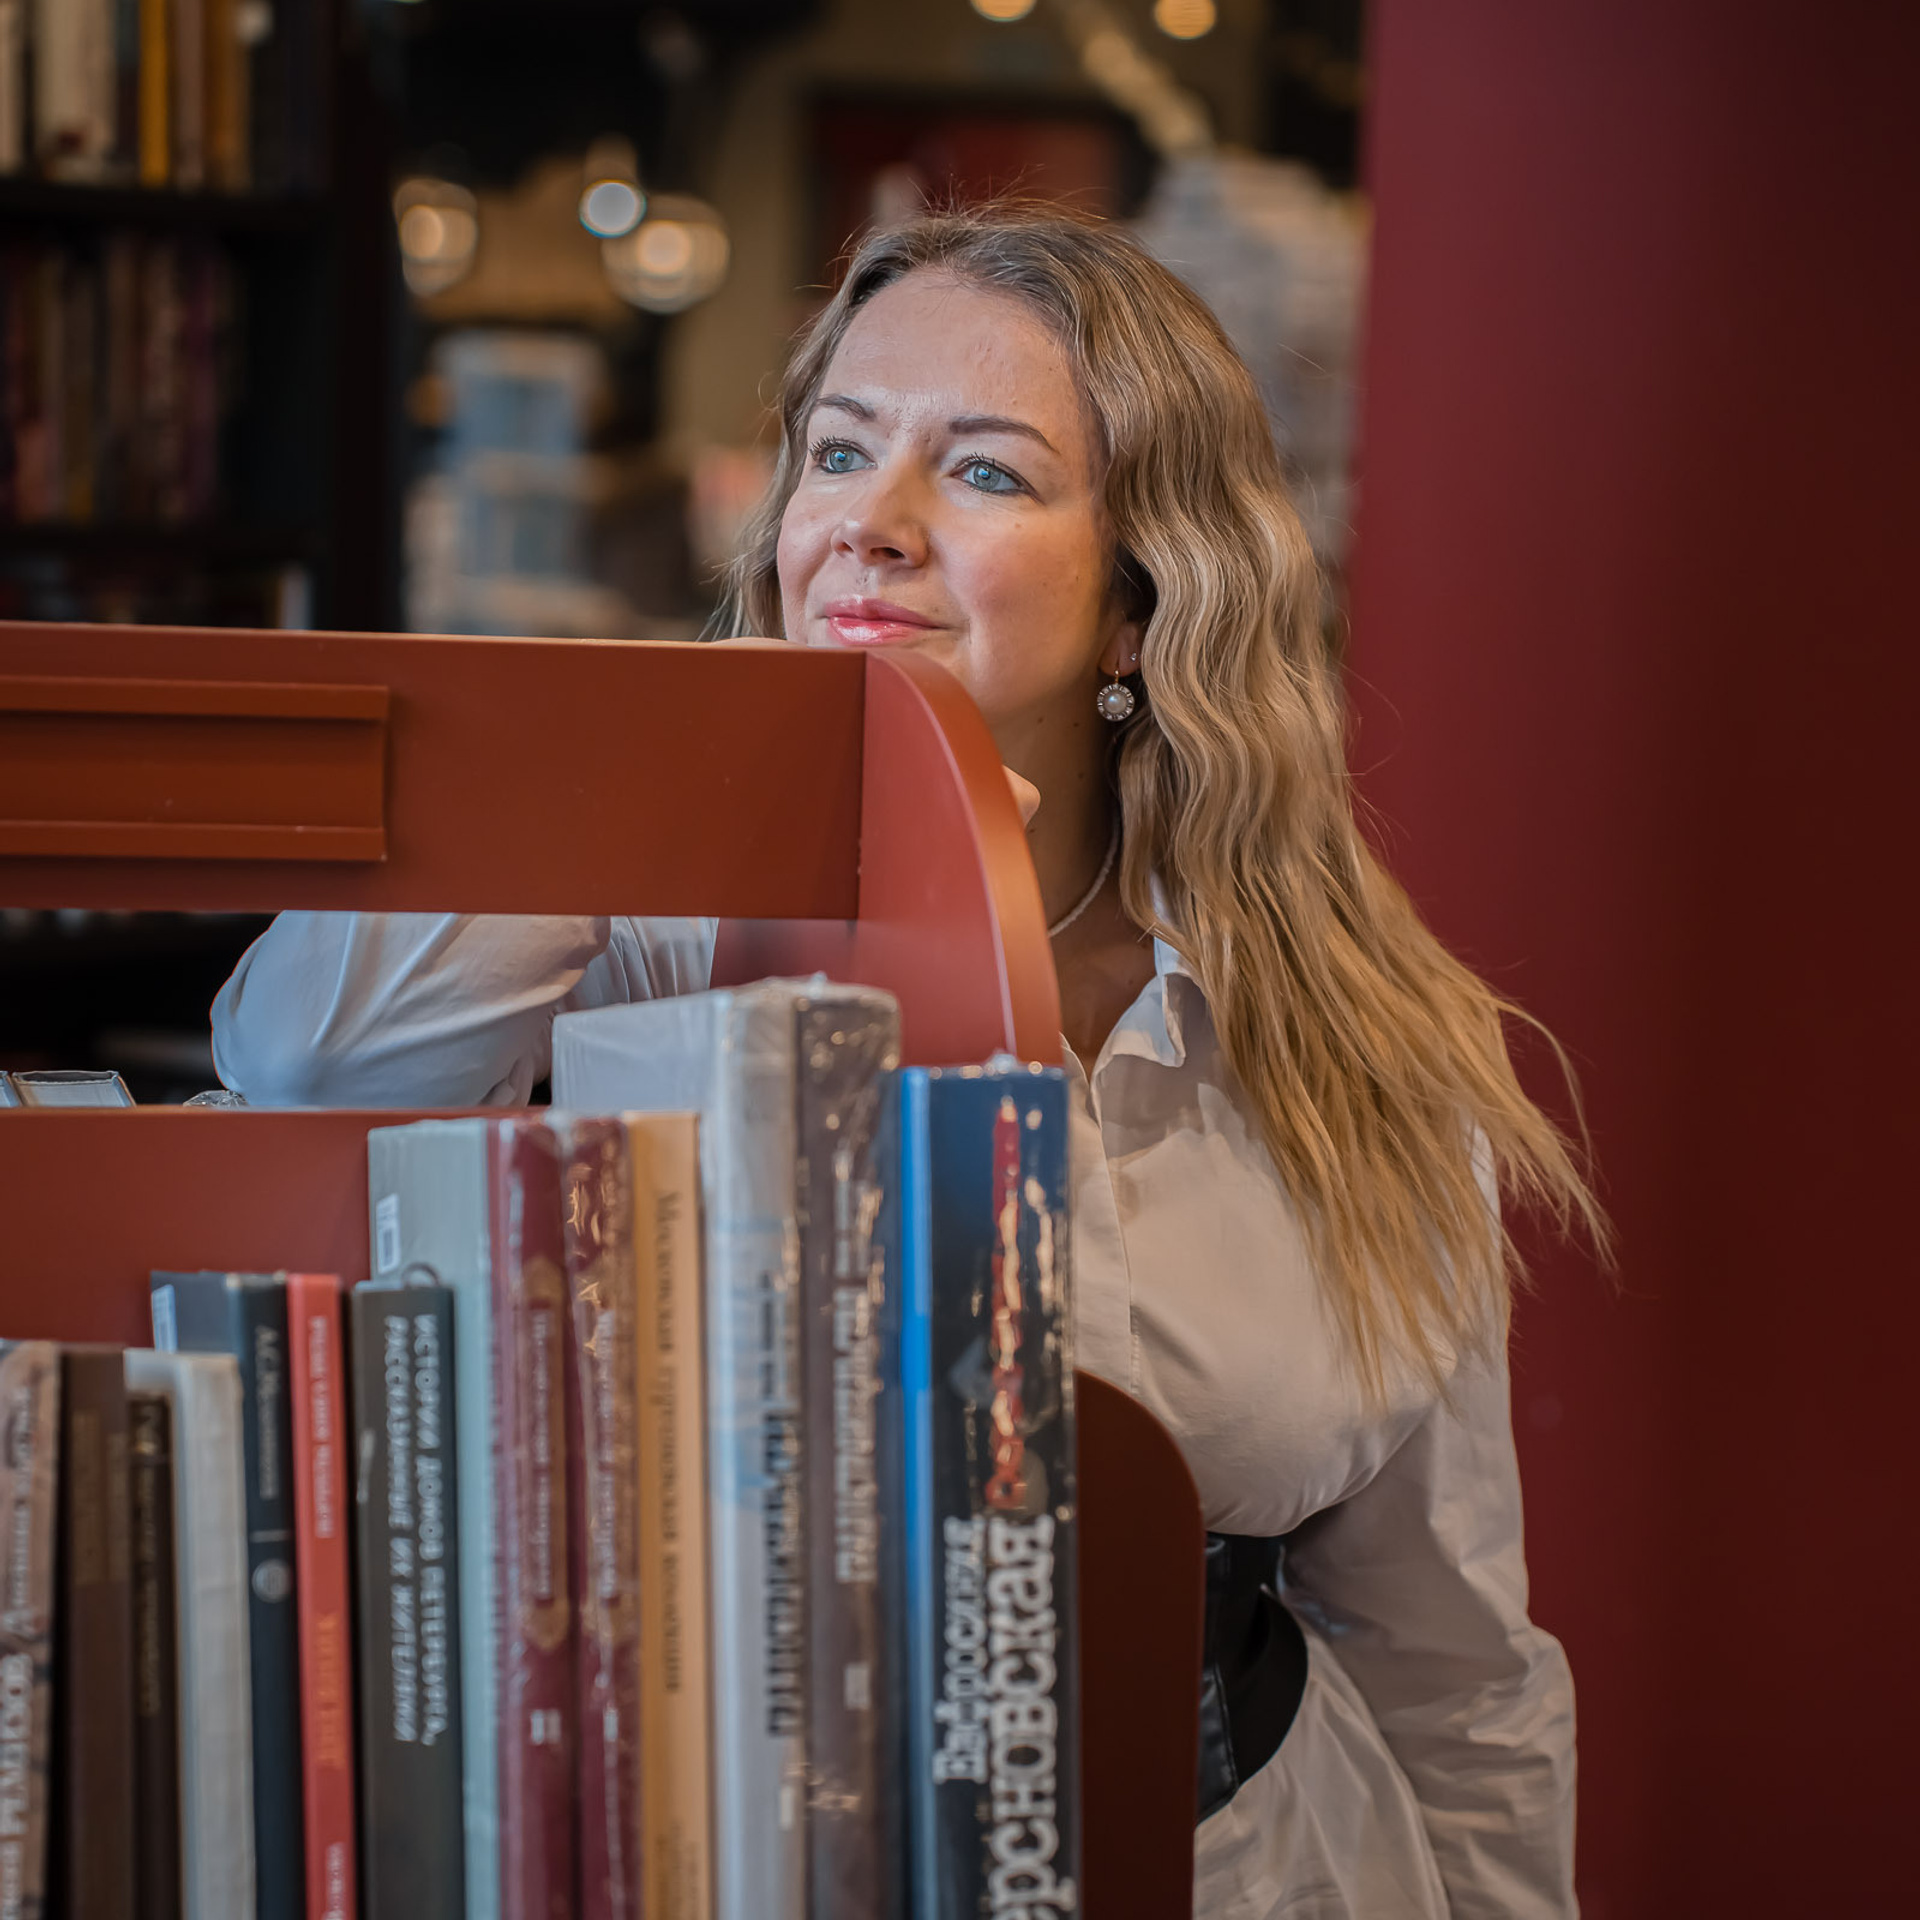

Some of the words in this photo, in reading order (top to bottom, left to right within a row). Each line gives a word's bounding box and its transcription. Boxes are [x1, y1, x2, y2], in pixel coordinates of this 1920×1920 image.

[389, 1537, 415, 1578] ИХ
[415, 1454, 444, 1560] ДОМОВ
[933, 1515, 990, 1784] Евфросиния
